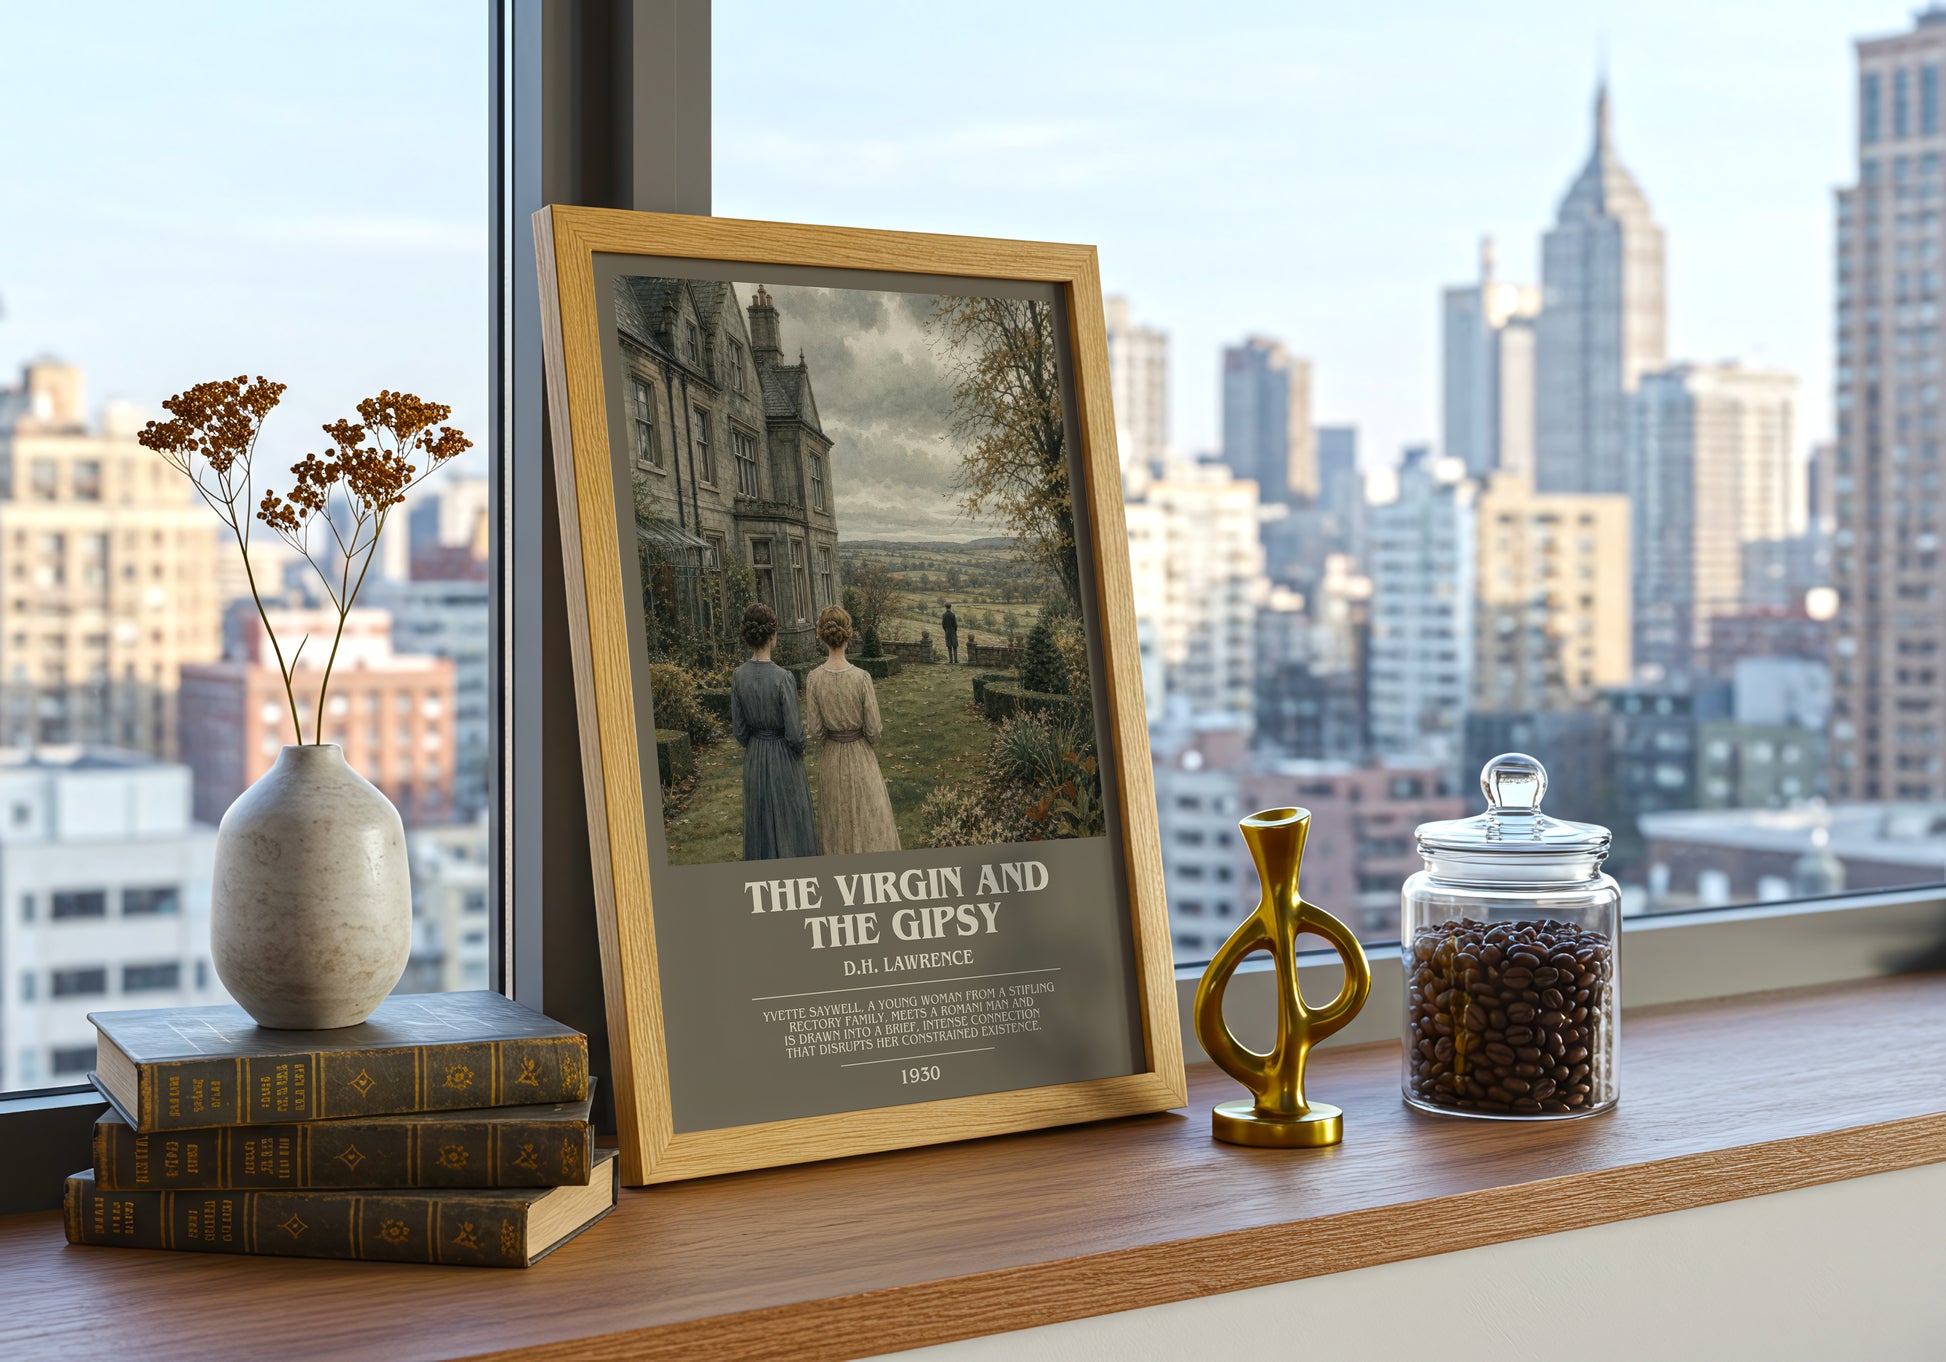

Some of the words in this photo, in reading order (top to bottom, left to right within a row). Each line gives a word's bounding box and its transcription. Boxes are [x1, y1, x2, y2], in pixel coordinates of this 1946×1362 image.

[743, 876, 823, 914] THE
[833, 866, 965, 907] VIRGIN
[975, 860, 1049, 896] AND
[804, 911, 881, 950] THE
[891, 901, 1002, 941] GIPSY
[843, 958, 878, 976] D.H.
[884, 949, 974, 973] LAWRENCE
[763, 1007, 806, 1022] YVETTE
[809, 1002, 865, 1018] SAYWELL,
[867, 1000, 876, 1011] A
[878, 996, 918, 1010] YOUNG
[920, 991, 963, 1006] WOMAN
[966, 988, 996, 1001] FROM
[998, 987, 1006, 998] A
[1008, 981, 1055, 996] STIFLING
[789, 1016, 842, 1033] RECTORY
[845, 1012, 888, 1027] FAMILY,
[891, 1007, 927, 1021] MEETS
[930, 1007, 938, 1018] A
[941, 1002, 983, 1016] ROMANI
[986, 999, 1009, 1012] MAN
[1012, 996, 1034, 1008] AND
[784, 1035, 796, 1047] IS
[799, 1029, 841, 1045] DRAWN
[844, 1026, 871, 1039] INTO
[874, 1025, 882, 1036] A
[885, 1021, 920, 1035] BRIEF,
[923, 1015, 968, 1031] INTENSE
[970, 1007, 1041, 1026] CONNECTION
[785, 1045, 817, 1059] THAT
[819, 1039, 874, 1056] DISRUPTS
[876, 1036, 899, 1049] HER
[901, 1027, 979, 1046] CONSTRAINED
[981, 1020, 1042, 1037] EXISTENCE.
[901, 1065, 941, 1085] 1930
